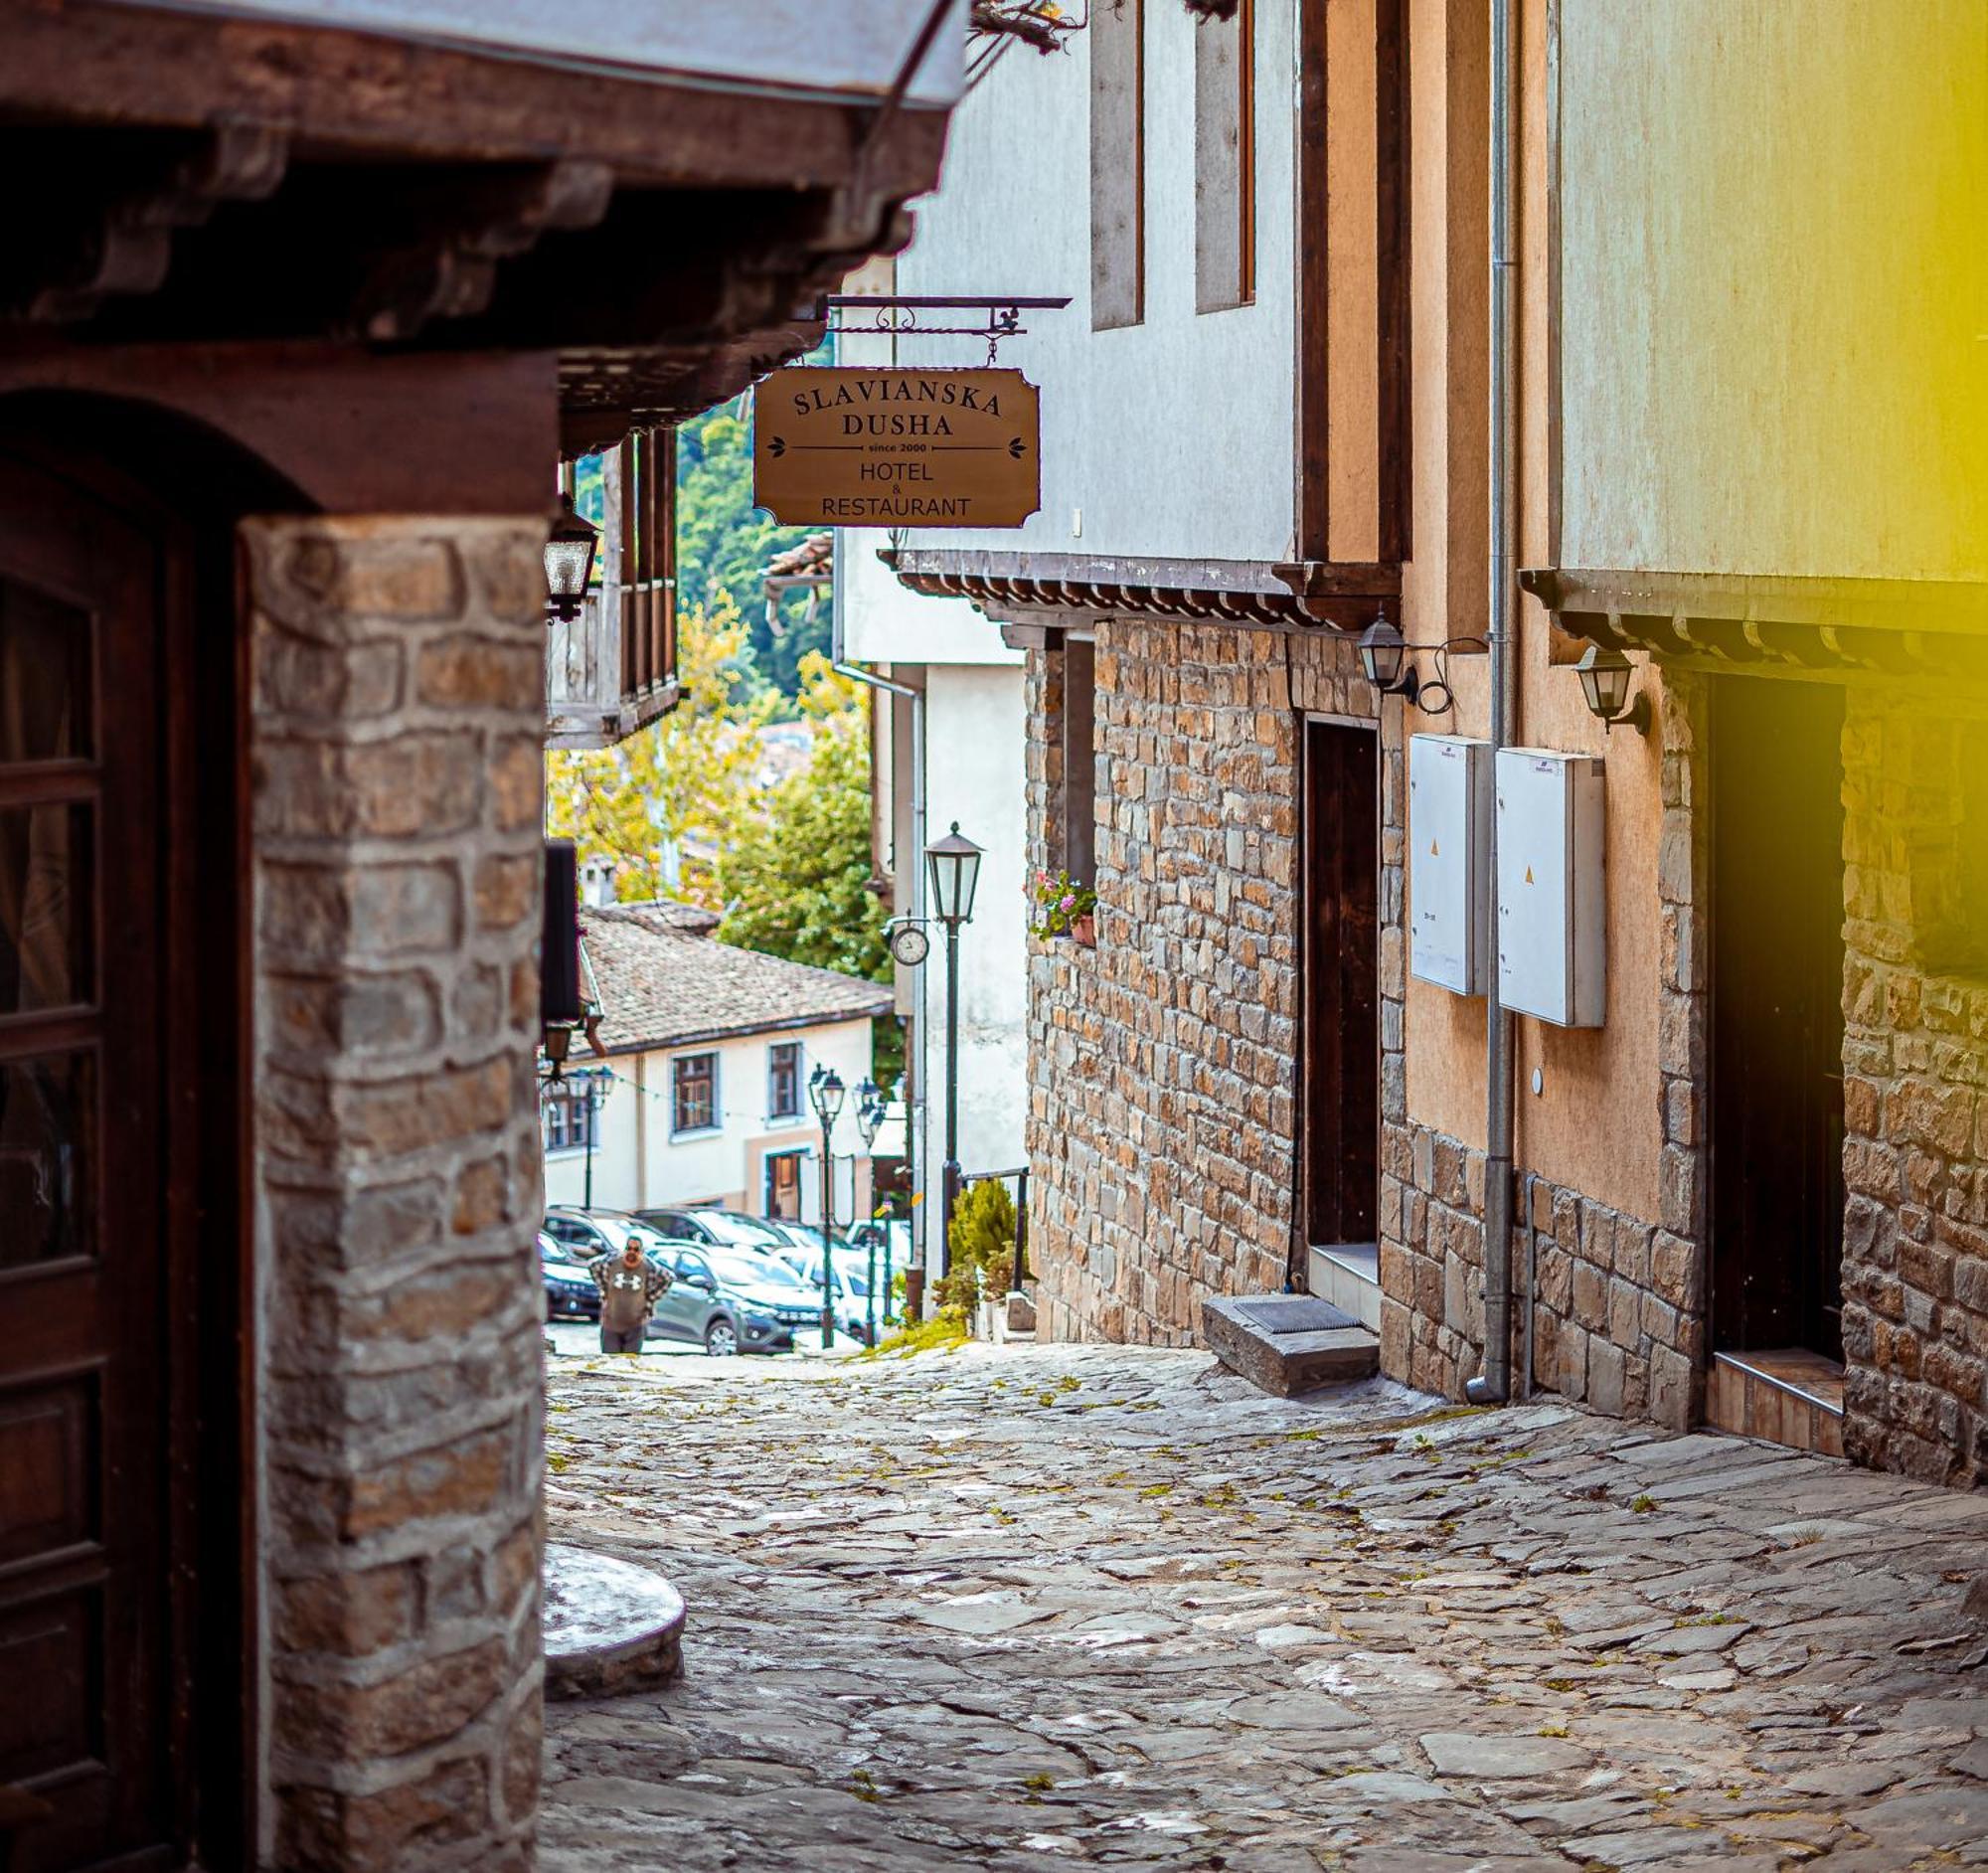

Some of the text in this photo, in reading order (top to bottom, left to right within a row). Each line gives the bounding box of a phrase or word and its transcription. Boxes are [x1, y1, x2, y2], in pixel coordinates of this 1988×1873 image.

[794, 380, 1002, 417] SLAVIANSKA
[843, 414, 953, 435] DUSHA
[869, 443, 926, 452] since 2000
[861, 463, 933, 481] HOTEL
[893, 484, 901, 494] &
[822, 498, 971, 516] RESTAURANT
